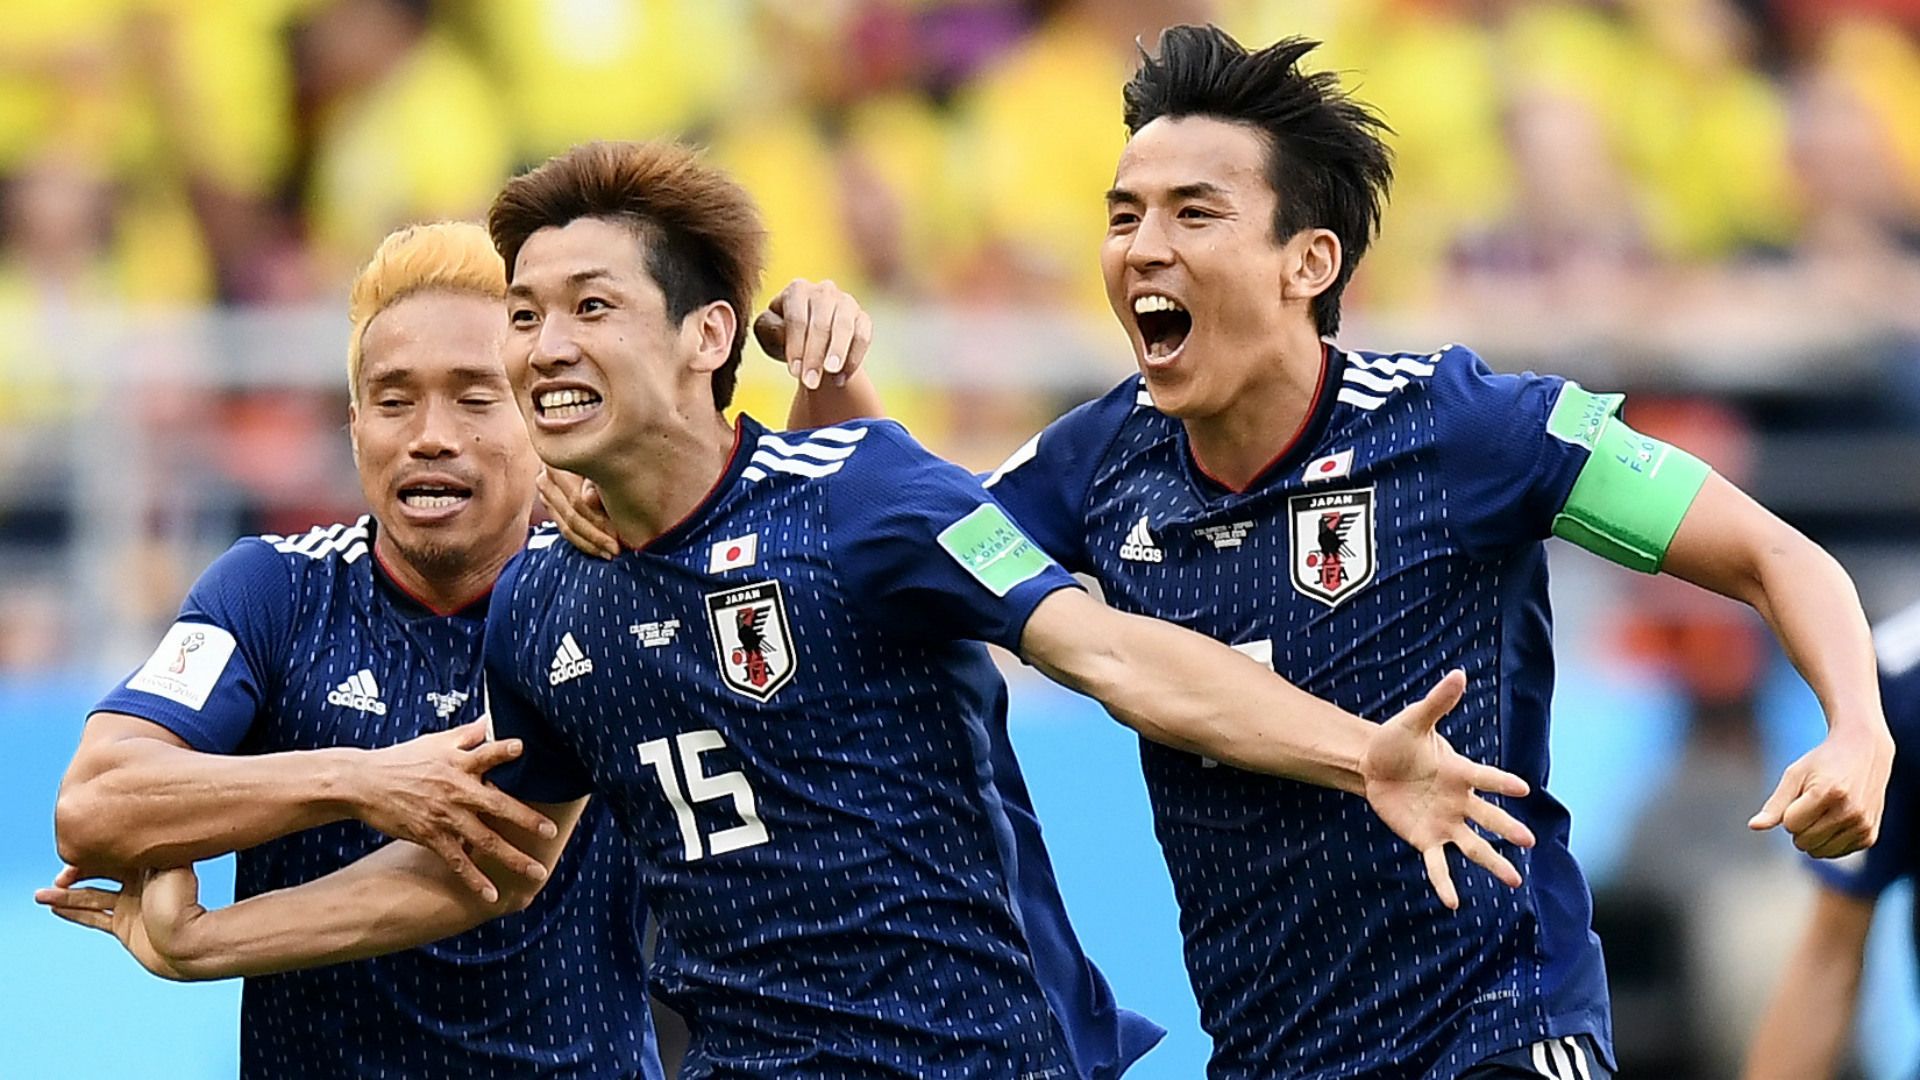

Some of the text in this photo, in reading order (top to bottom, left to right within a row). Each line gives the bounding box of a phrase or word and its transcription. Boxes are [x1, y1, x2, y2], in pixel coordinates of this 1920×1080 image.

[1310, 494, 1353, 508] JAPAN
[1314, 566, 1349, 586] JFA
[724, 588, 762, 606] JAPAN
[549, 657, 593, 686] adidas
[742, 661, 776, 683] JFA
[327, 690, 387, 716] adidas
[637, 729, 769, 862] 15
